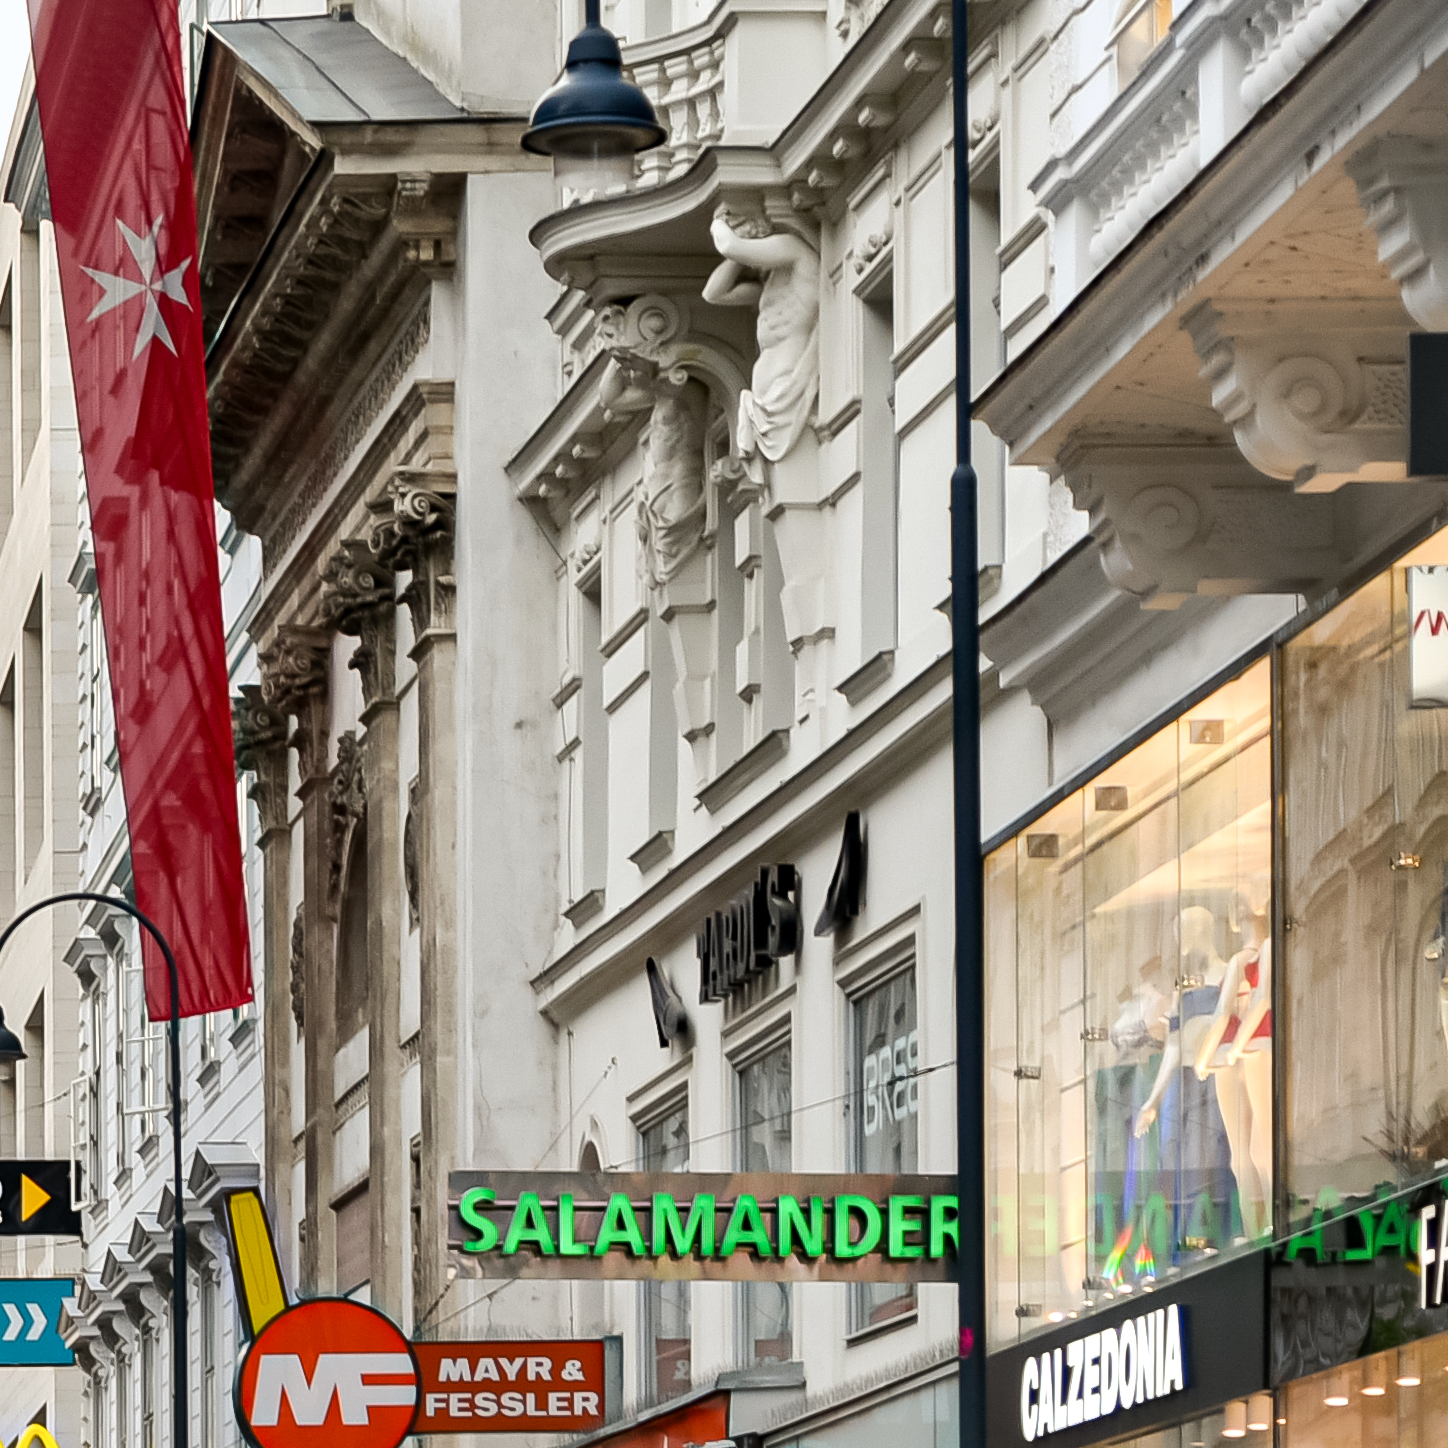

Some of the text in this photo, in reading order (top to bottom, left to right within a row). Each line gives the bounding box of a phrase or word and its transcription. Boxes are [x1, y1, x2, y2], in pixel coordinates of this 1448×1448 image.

[458, 1186, 959, 1258] SALAMANDER
[438, 1357, 586, 1383] MAYR &
[1020, 1303, 1185, 1442] CALZEDONIA
[425, 1391, 600, 1418] FESSLER
